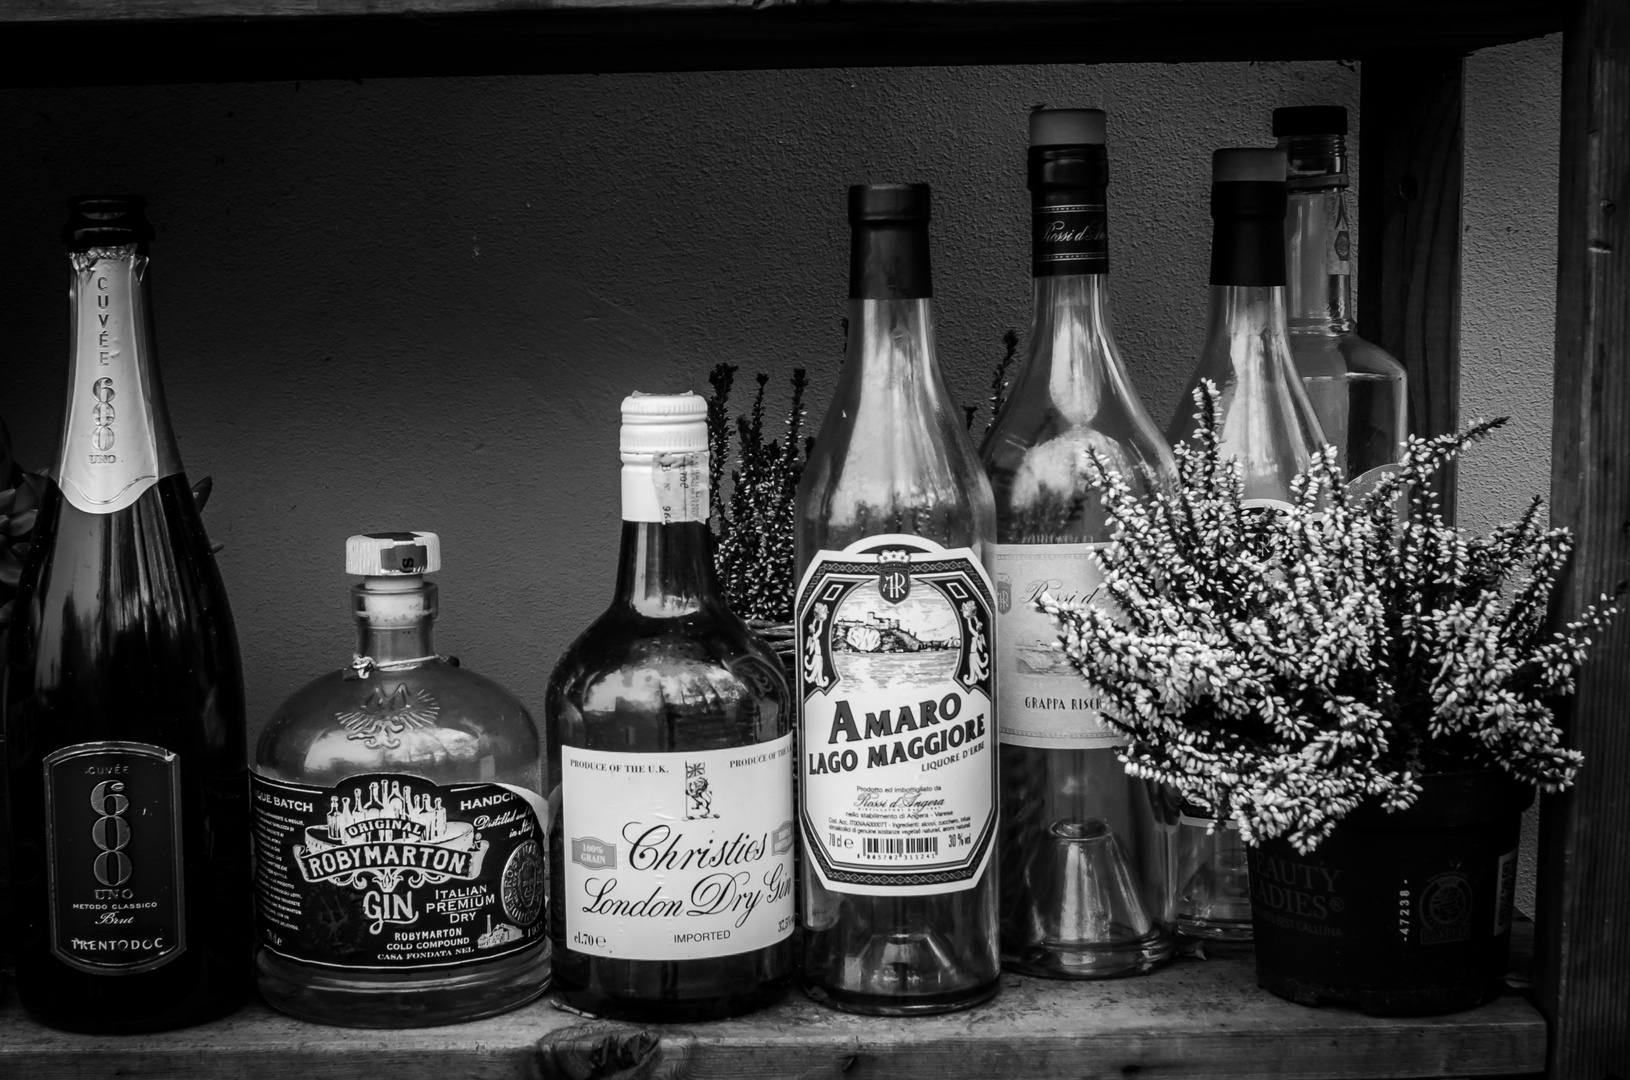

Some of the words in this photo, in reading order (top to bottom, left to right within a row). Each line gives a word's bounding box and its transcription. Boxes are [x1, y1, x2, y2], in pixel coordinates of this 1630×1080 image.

[88, 454, 118, 464] UNO
[1025, 696, 1066, 710] GRAPPA
[1071, 697, 1102, 710] RISER
[828, 692, 962, 745] AMARO
[809, 749, 858, 775] LAGO
[867, 713, 986, 768] MAGGIORE
[730, 754, 768, 768] PRODUCE
[768, 751, 777, 760] OF
[921, 754, 960, 772] LIQUORE
[962, 740, 985, 759] D'ERBE
[88, 763, 130, 775] CUVÉE
[570, 758, 607, 772] PRODUCE
[609, 764, 622, 772] OF
[624, 765, 646, 773] THE
[648, 765, 670, 773] U.K.
[894, 785, 933, 794] imbottigliato
[274, 796, 313, 812] BATCH
[854, 792, 887, 808] Rossi
[474, 809, 517, 830] Distilled
[906, 812, 929, 820] Angera
[938, 818, 960, 826] zucchero,
[90, 779, 132, 887] 600
[348, 820, 422, 836] ORIGINAL
[509, 828, 517, 838] in
[622, 821, 768, 871] Christies
[828, 833, 836, 847] 70
[948, 834, 957, 848] 30
[582, 844, 604, 854] 100%
[308, 846, 466, 877] ROBYMARTON
[580, 853, 606, 864] GRAIN
[94, 888, 134, 900] UNO
[436, 884, 488, 900] ITALIAN
[582, 877, 684, 917] London
[686, 871, 764, 928] Dry
[764, 863, 792, 903] Gin
[426, 894, 495, 913] PREMIUM
[95, 911, 134, 925] Brut
[363, 890, 419, 934] GIN
[450, 912, 477, 924] DRY
[394, 928, 462, 940] ROBYMARTON
[674, 930, 731, 943] IMPORTED
[386, 942, 414, 950] COLD
[416, 938, 470, 950] COMPOUND
[406, 950, 453, 960] FONDATA
